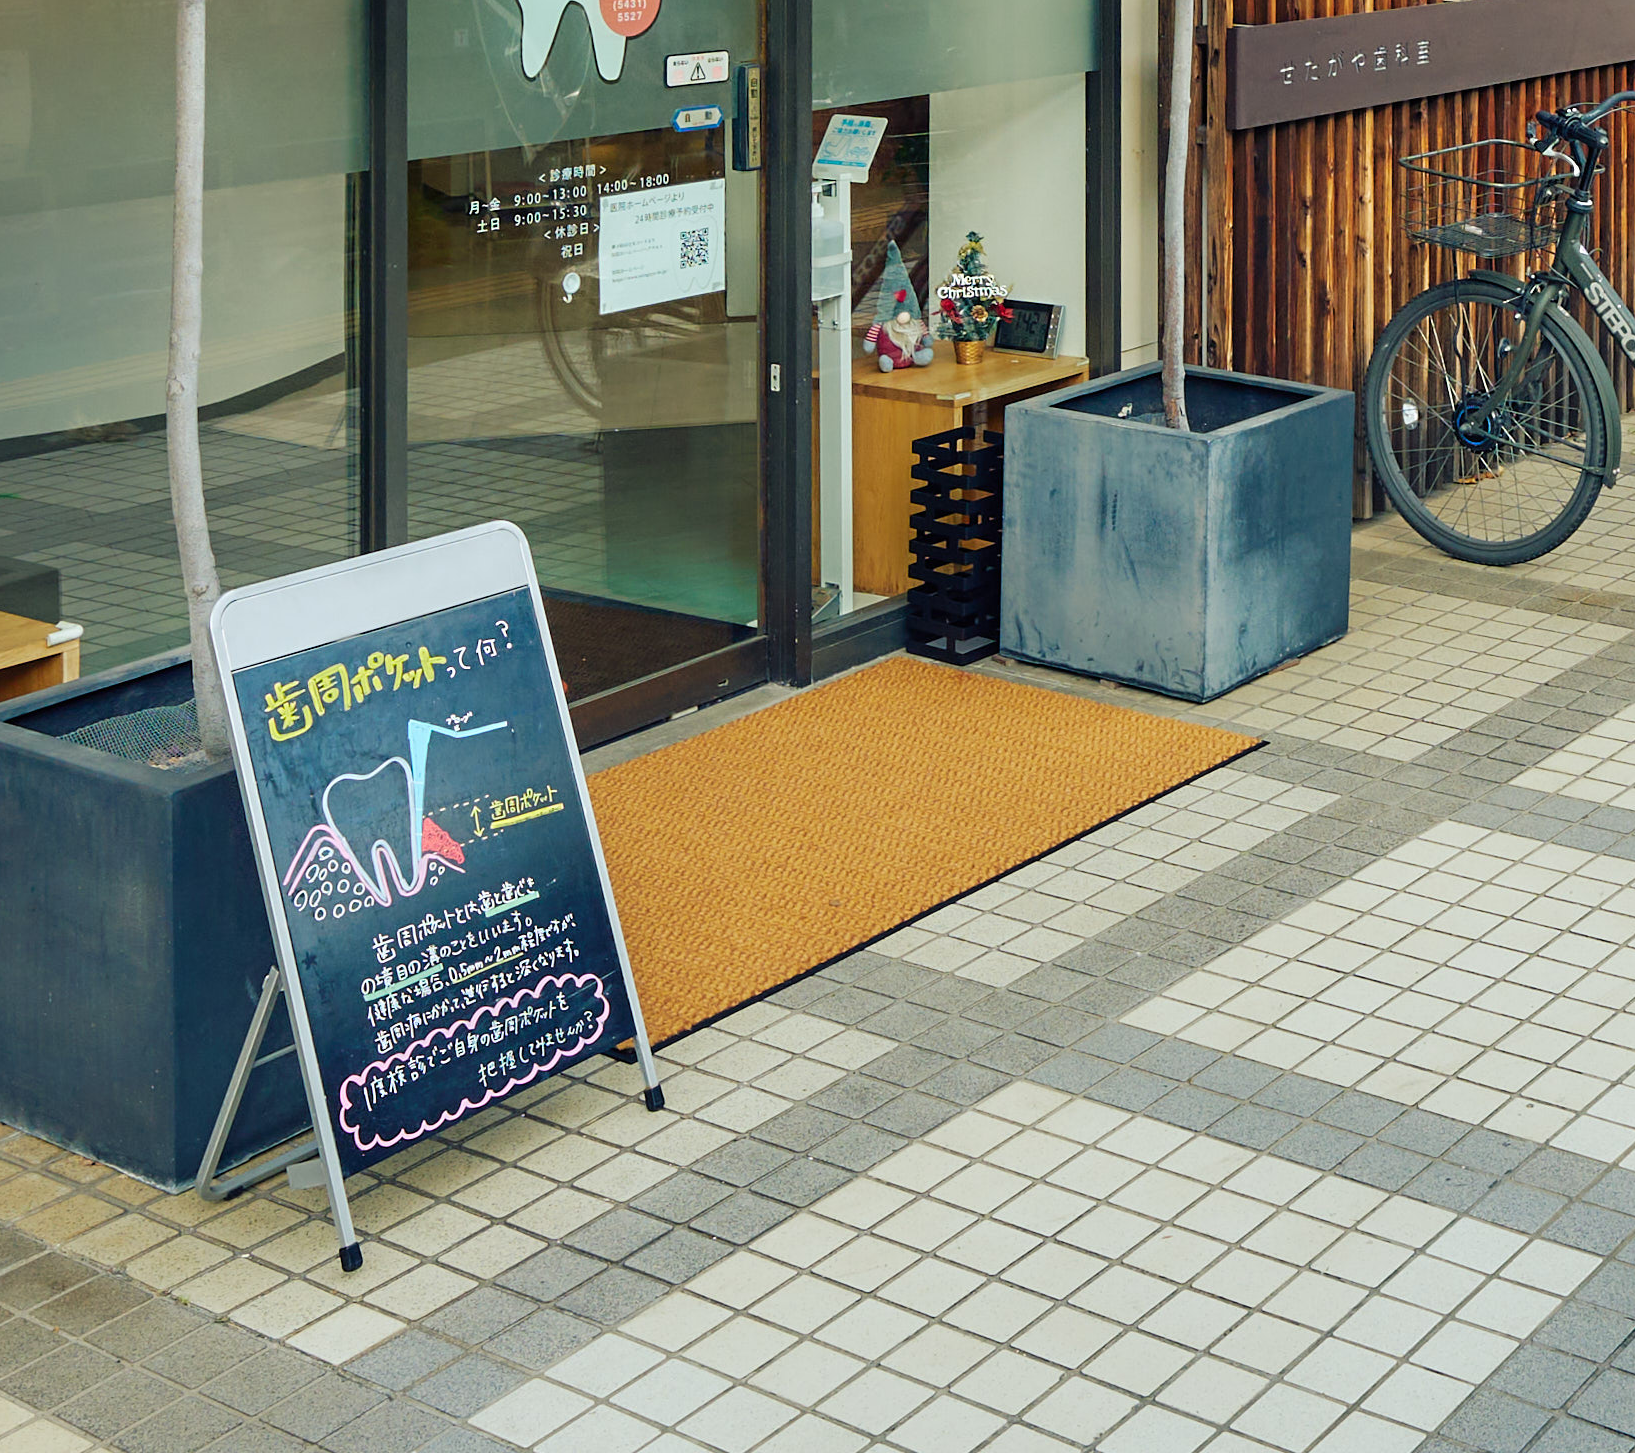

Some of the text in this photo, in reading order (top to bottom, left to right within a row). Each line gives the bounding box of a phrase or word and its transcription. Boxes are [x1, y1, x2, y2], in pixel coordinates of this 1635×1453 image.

[617, 10, 644, 23] 5527
[1279, 39, 1431, 86] せたがや歯科室
[475, 217, 502, 235] 土日
[560, 242, 585, 259] 祝日
[950, 272, 995, 288] Merry
[936, 284, 1008, 300] Christmas
[263, 619, 513, 742] 歯周ポケットって何?
[488, 784, 558, 821] 歯周ポケット
